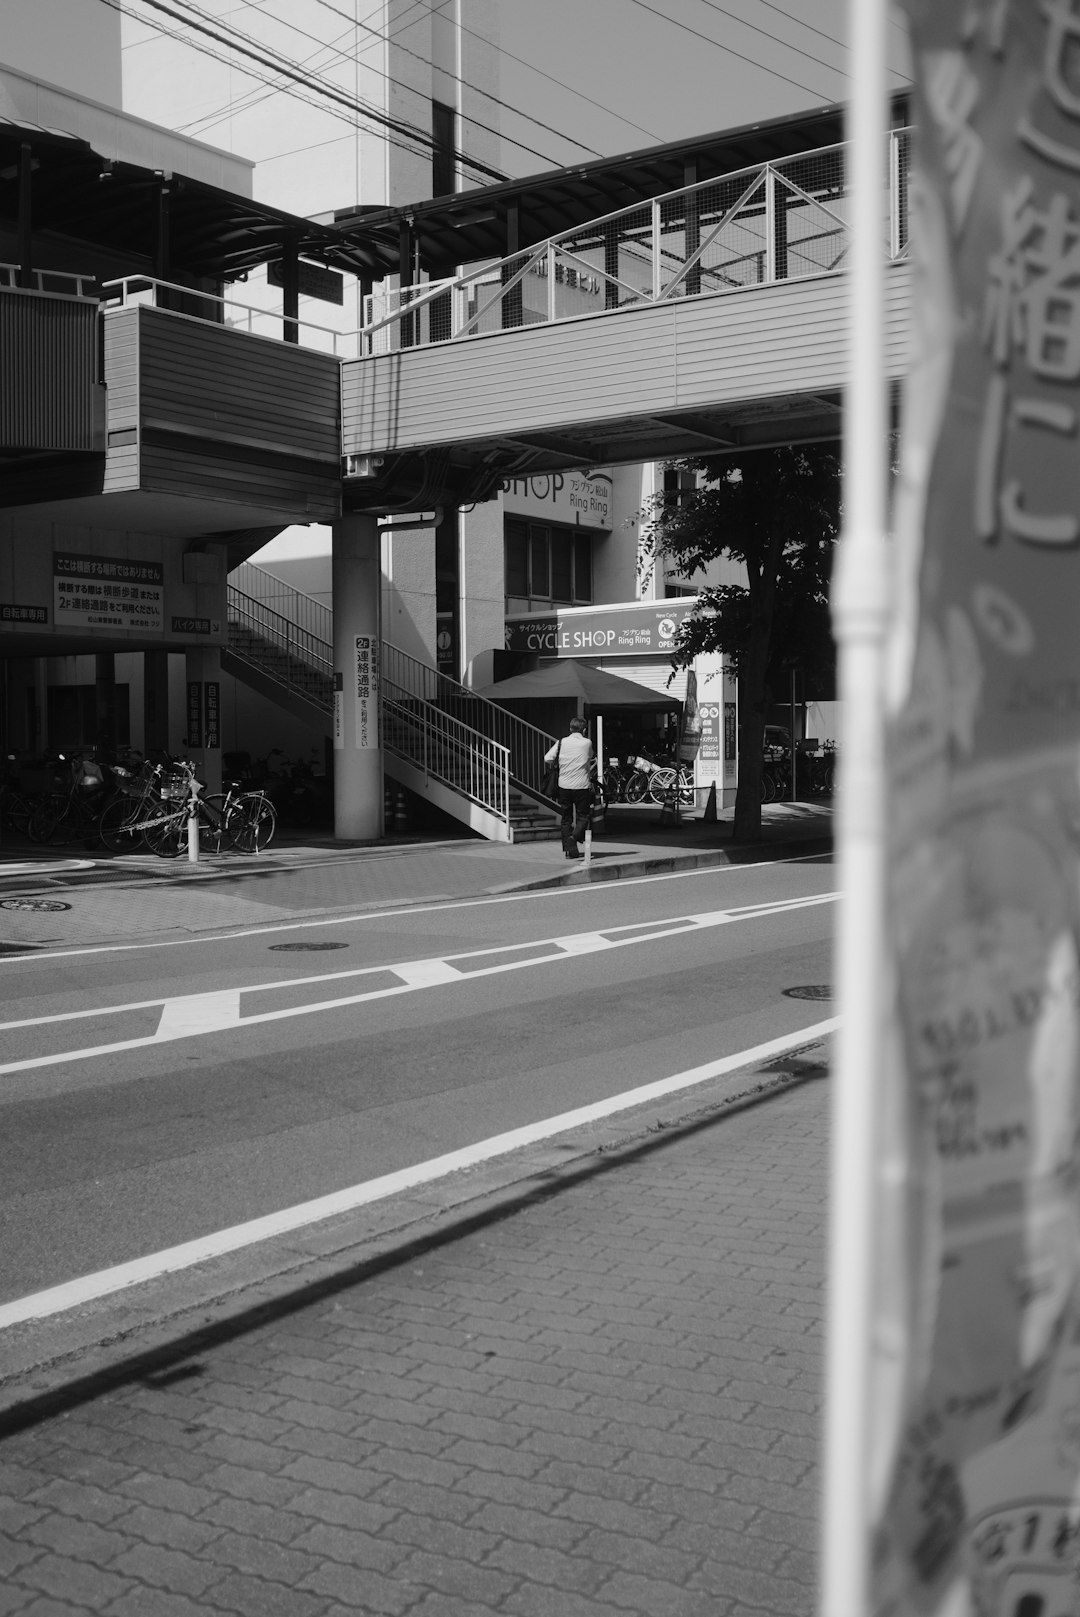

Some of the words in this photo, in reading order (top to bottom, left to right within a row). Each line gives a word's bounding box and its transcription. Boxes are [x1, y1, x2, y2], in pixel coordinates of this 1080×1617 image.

[569, 492, 588, 513] Ring
[590, 496, 608, 516] Ring
[57, 558, 160, 580] ここは横断する場所ではありません
[3, 606, 45, 621] 自転車専用
[520, 622, 563, 631] サイクルショップ
[357, 639, 368, 648] 2F
[527, 632, 570, 649] CYCLE
[573, 630, 615, 648] SHOP
[618, 637, 634, 646] Ring
[635, 635, 651, 645] Ring
[357, 650, 369, 698] 連絡通路
[208, 685, 217, 745] 自転車専用
